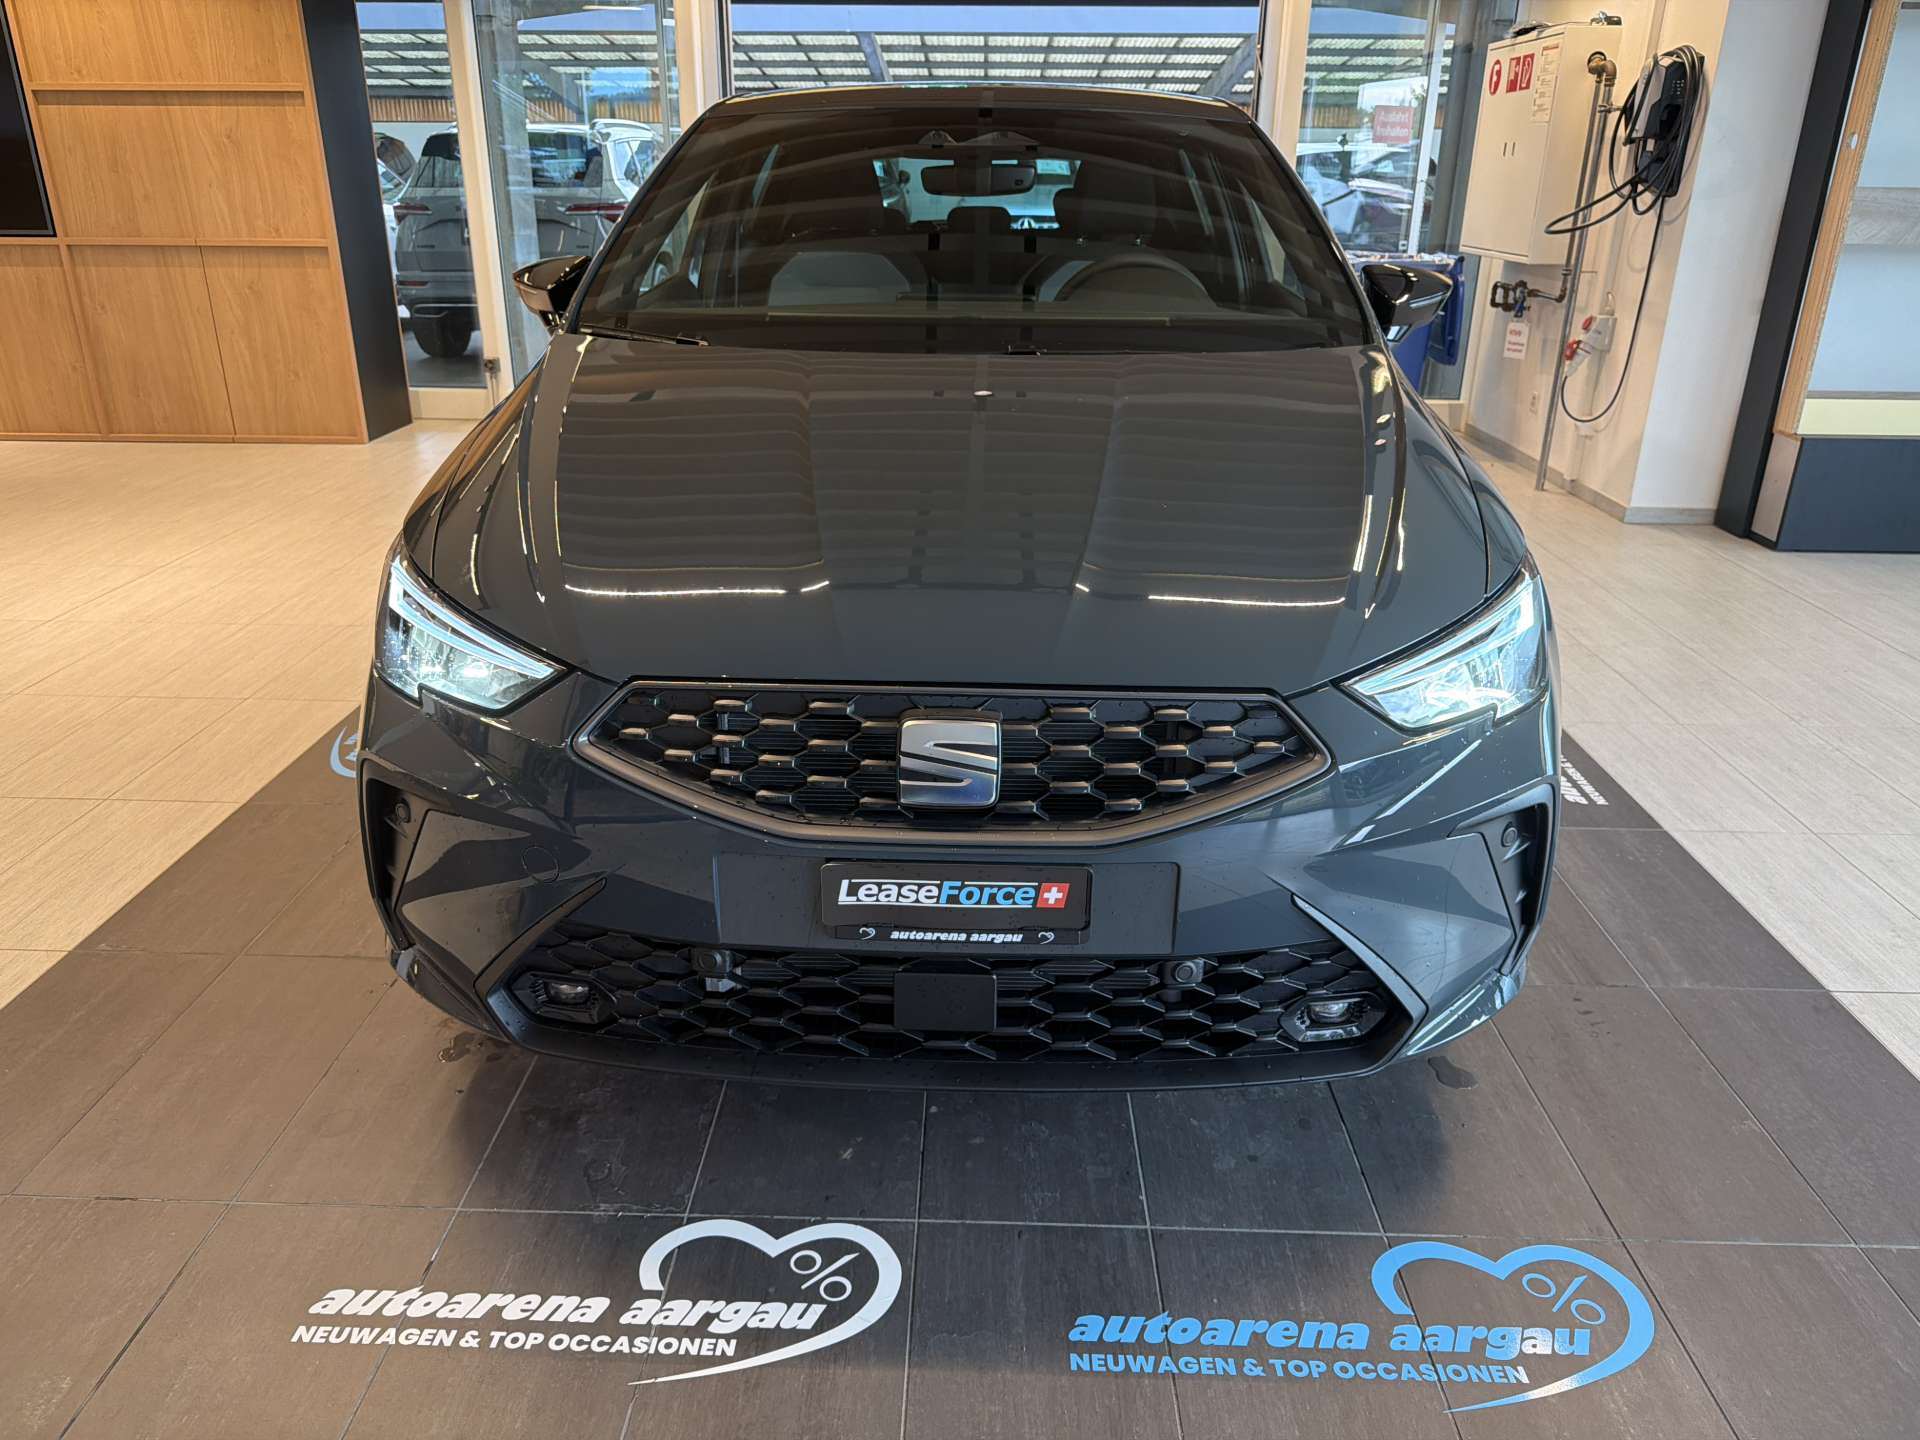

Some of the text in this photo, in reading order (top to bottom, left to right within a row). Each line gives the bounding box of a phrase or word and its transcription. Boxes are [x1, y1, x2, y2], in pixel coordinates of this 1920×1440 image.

[838, 879, 1036, 906] LeaseForce
[890, 928, 1024, 944] autoarena aargau
[308, 1285, 827, 1335] autoarena aargau
[290, 1325, 738, 1357] NEUWAGEN & TOP OCCASIONEN
[1068, 1311, 1591, 1361] autoarena aargau
[1069, 1353, 1531, 1384] NEUWAGEN & TOP OCCASIONEN
